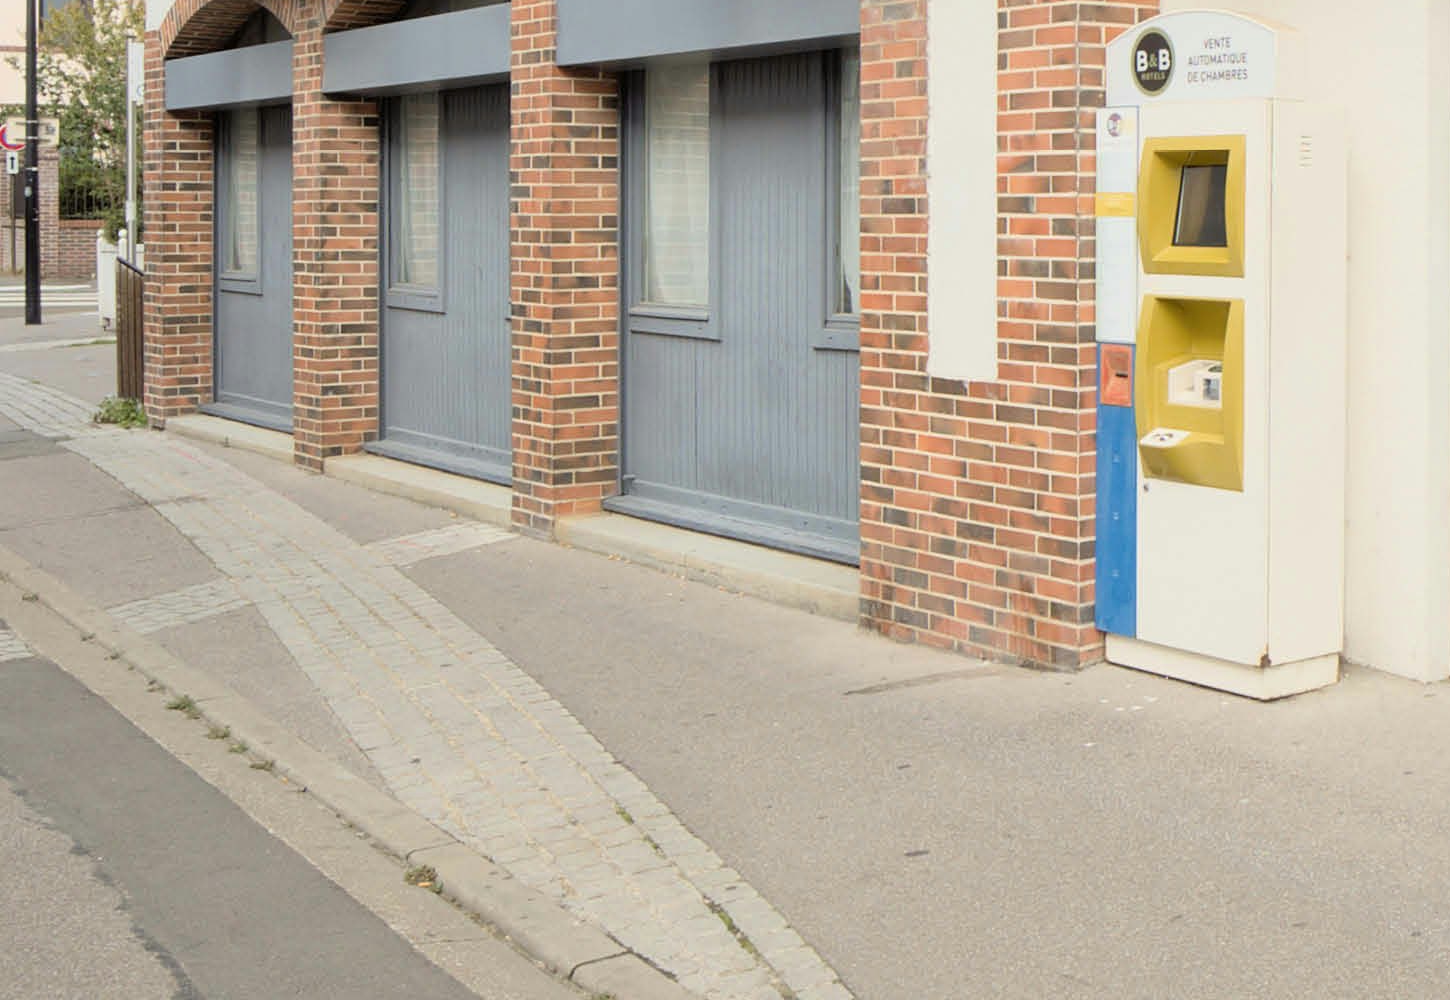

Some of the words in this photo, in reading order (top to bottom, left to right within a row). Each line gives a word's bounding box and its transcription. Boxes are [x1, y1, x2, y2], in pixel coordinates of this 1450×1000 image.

[1203, 36, 1232, 49] VENTE
[1136, 49, 1171, 72] B&B
[1187, 53, 1248, 66] AUTOMATIQUE
[1187, 71, 1198, 83] DE
[1200, 69, 1249, 82] CHAMBRES
